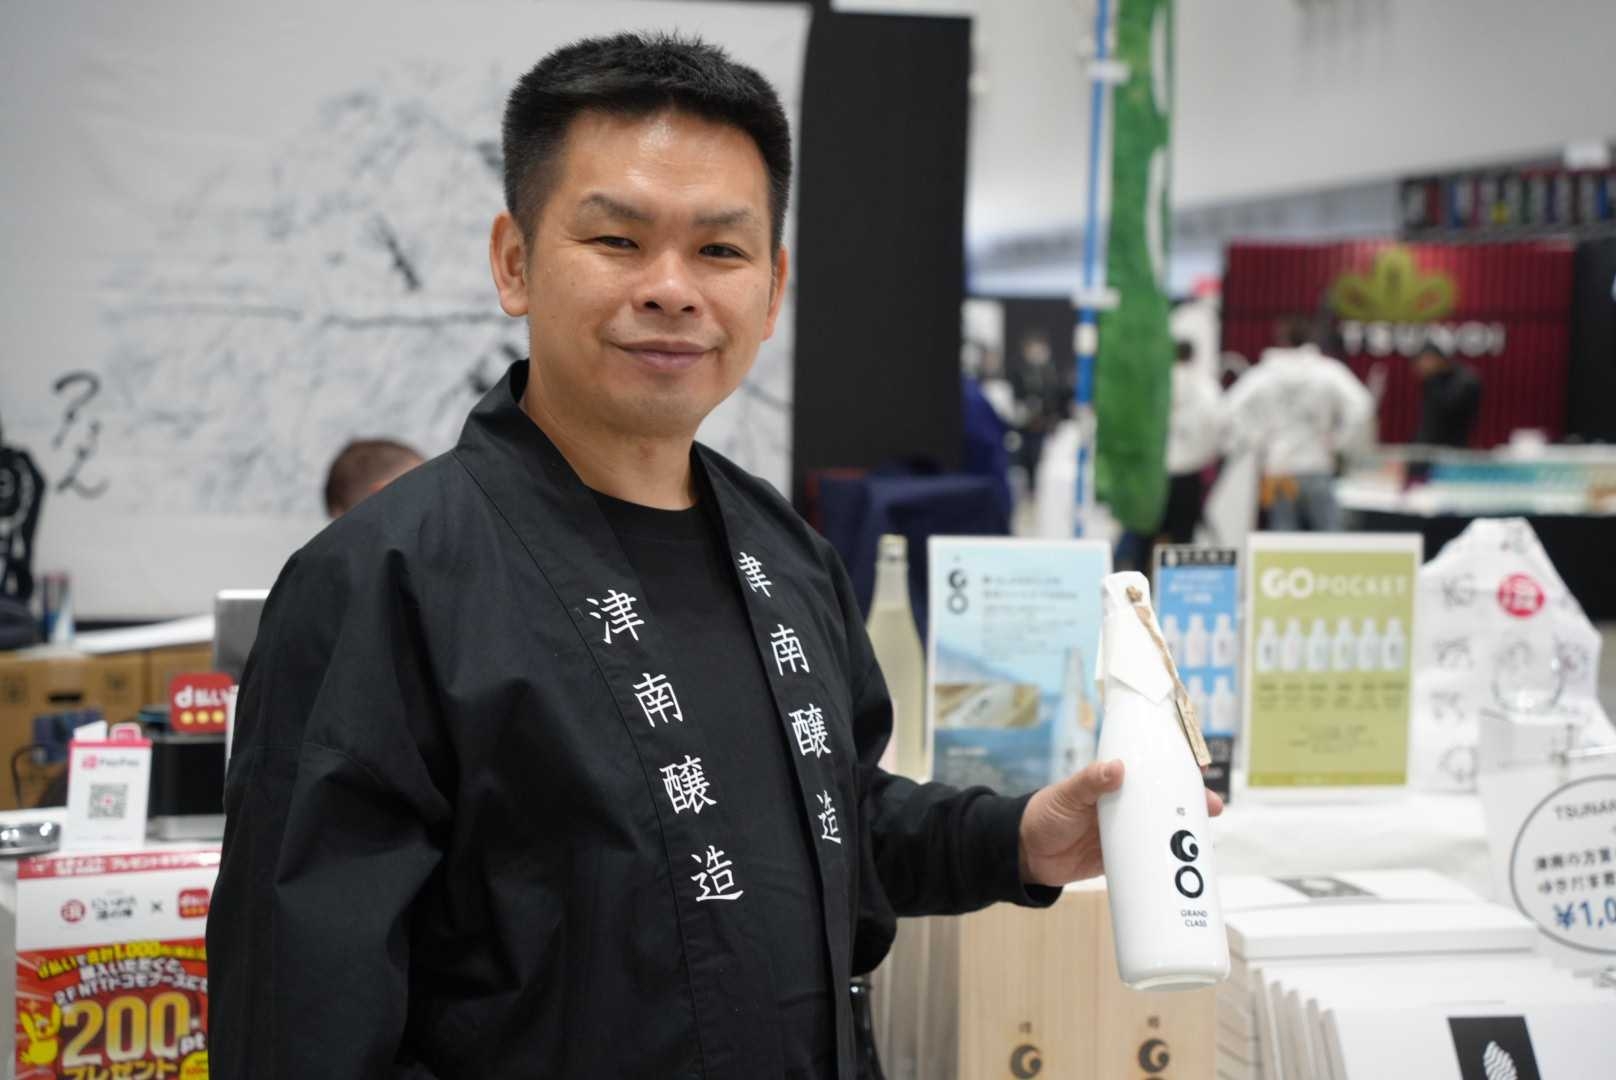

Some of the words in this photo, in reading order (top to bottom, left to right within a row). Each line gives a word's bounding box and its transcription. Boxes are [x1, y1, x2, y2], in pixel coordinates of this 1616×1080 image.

[1261, 567, 1313, 598] GO
[1315, 576, 1408, 596] POCKET
[738, 551, 842, 844] 津南醸造
[586, 589, 744, 902] 津南醸造
[1180, 908, 1208, 918] GRAND
[1184, 918, 1208, 928] CLASS
[63, 992, 191, 1067] 200
